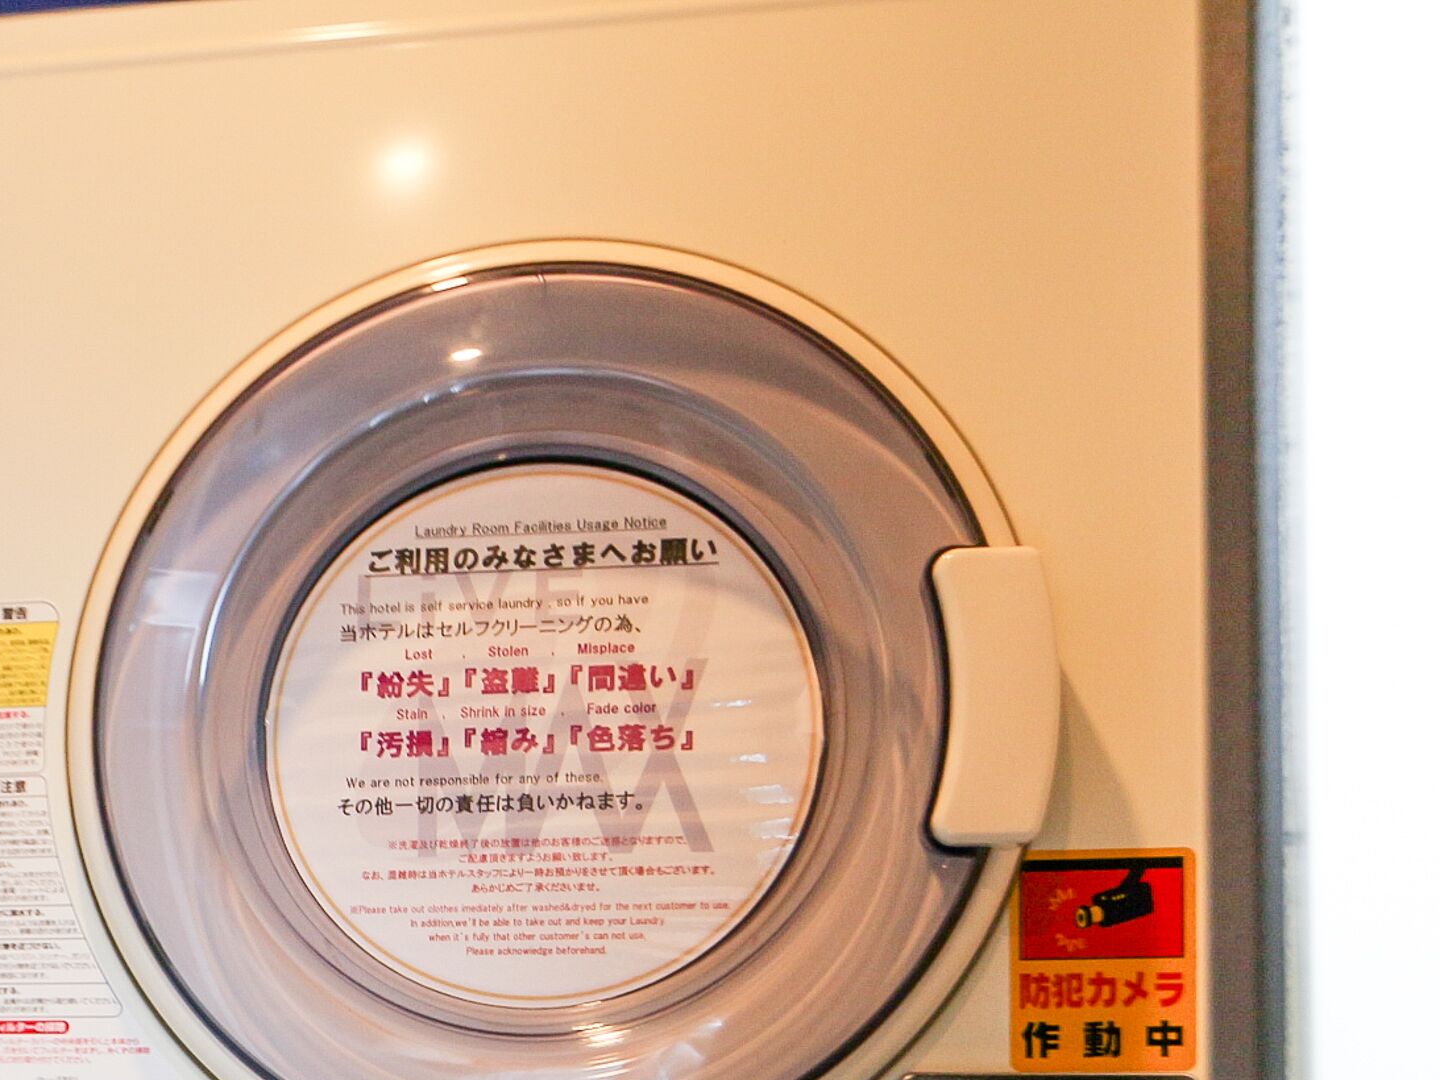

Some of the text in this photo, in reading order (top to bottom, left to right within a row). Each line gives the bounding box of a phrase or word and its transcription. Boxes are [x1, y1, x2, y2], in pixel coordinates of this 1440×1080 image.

[414, 515, 667, 538] Laundry Room Facilities Usage Notice
[368, 538, 719, 575] ご利用のみなさまへお願い
[340, 602, 365, 616] This
[369, 601, 401, 614] hotel
[498, 597, 542, 613] laundry
[590, 596, 614, 610] you
[618, 593, 649, 606] have
[405, 642, 636, 660] Lost Stolen Misplace
[396, 701, 657, 721] Stain Shrink in size Fade color
[346, 776, 366, 789] We
[370, 778, 390, 788] are
[395, 776, 415, 788] not
[419, 774, 490, 790] responsible
[495, 772, 513, 785] for
[519, 774, 541, 788] any
[546, 771, 560, 784] of
[615, 901, 630, 911] the
[632, 901, 653, 911] next
[1018, 972, 1185, 1010] 防犯カメラ
[1021, 1020, 1184, 1059] 作動中
